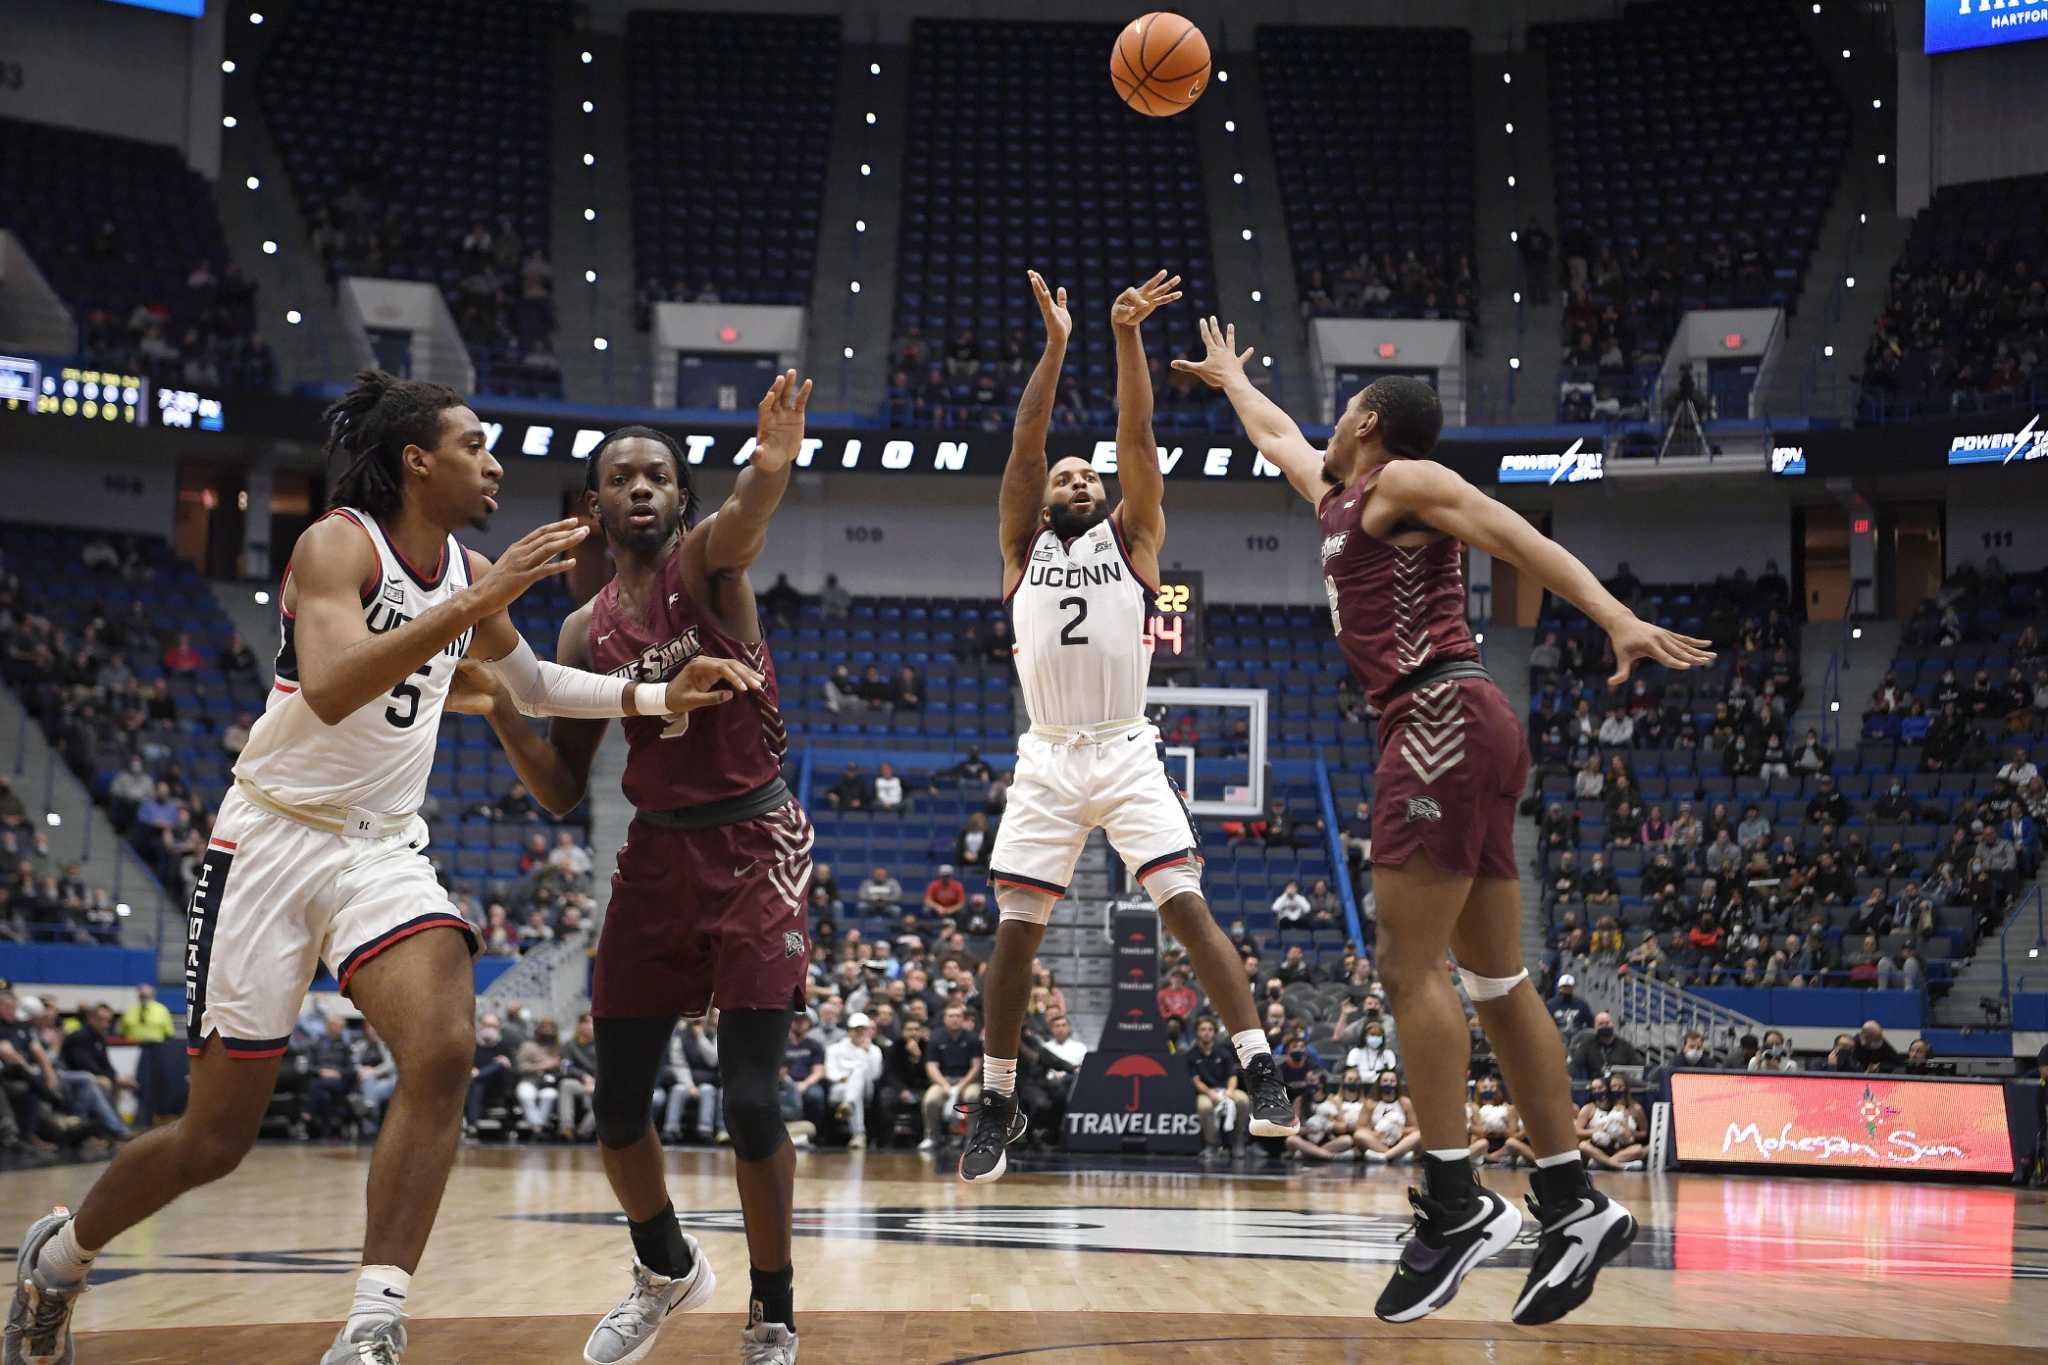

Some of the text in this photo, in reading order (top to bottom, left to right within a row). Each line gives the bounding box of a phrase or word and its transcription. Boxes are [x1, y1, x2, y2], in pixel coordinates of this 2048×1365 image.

[1030, 562, 1122, 588] UCONN
[1155, 585, 1190, 612] 22
[1059, 597, 1089, 646] 2
[1066, 1112, 1200, 1135] TRAVELERS
[1722, 1122, 1968, 1163] Mohegan Sun
